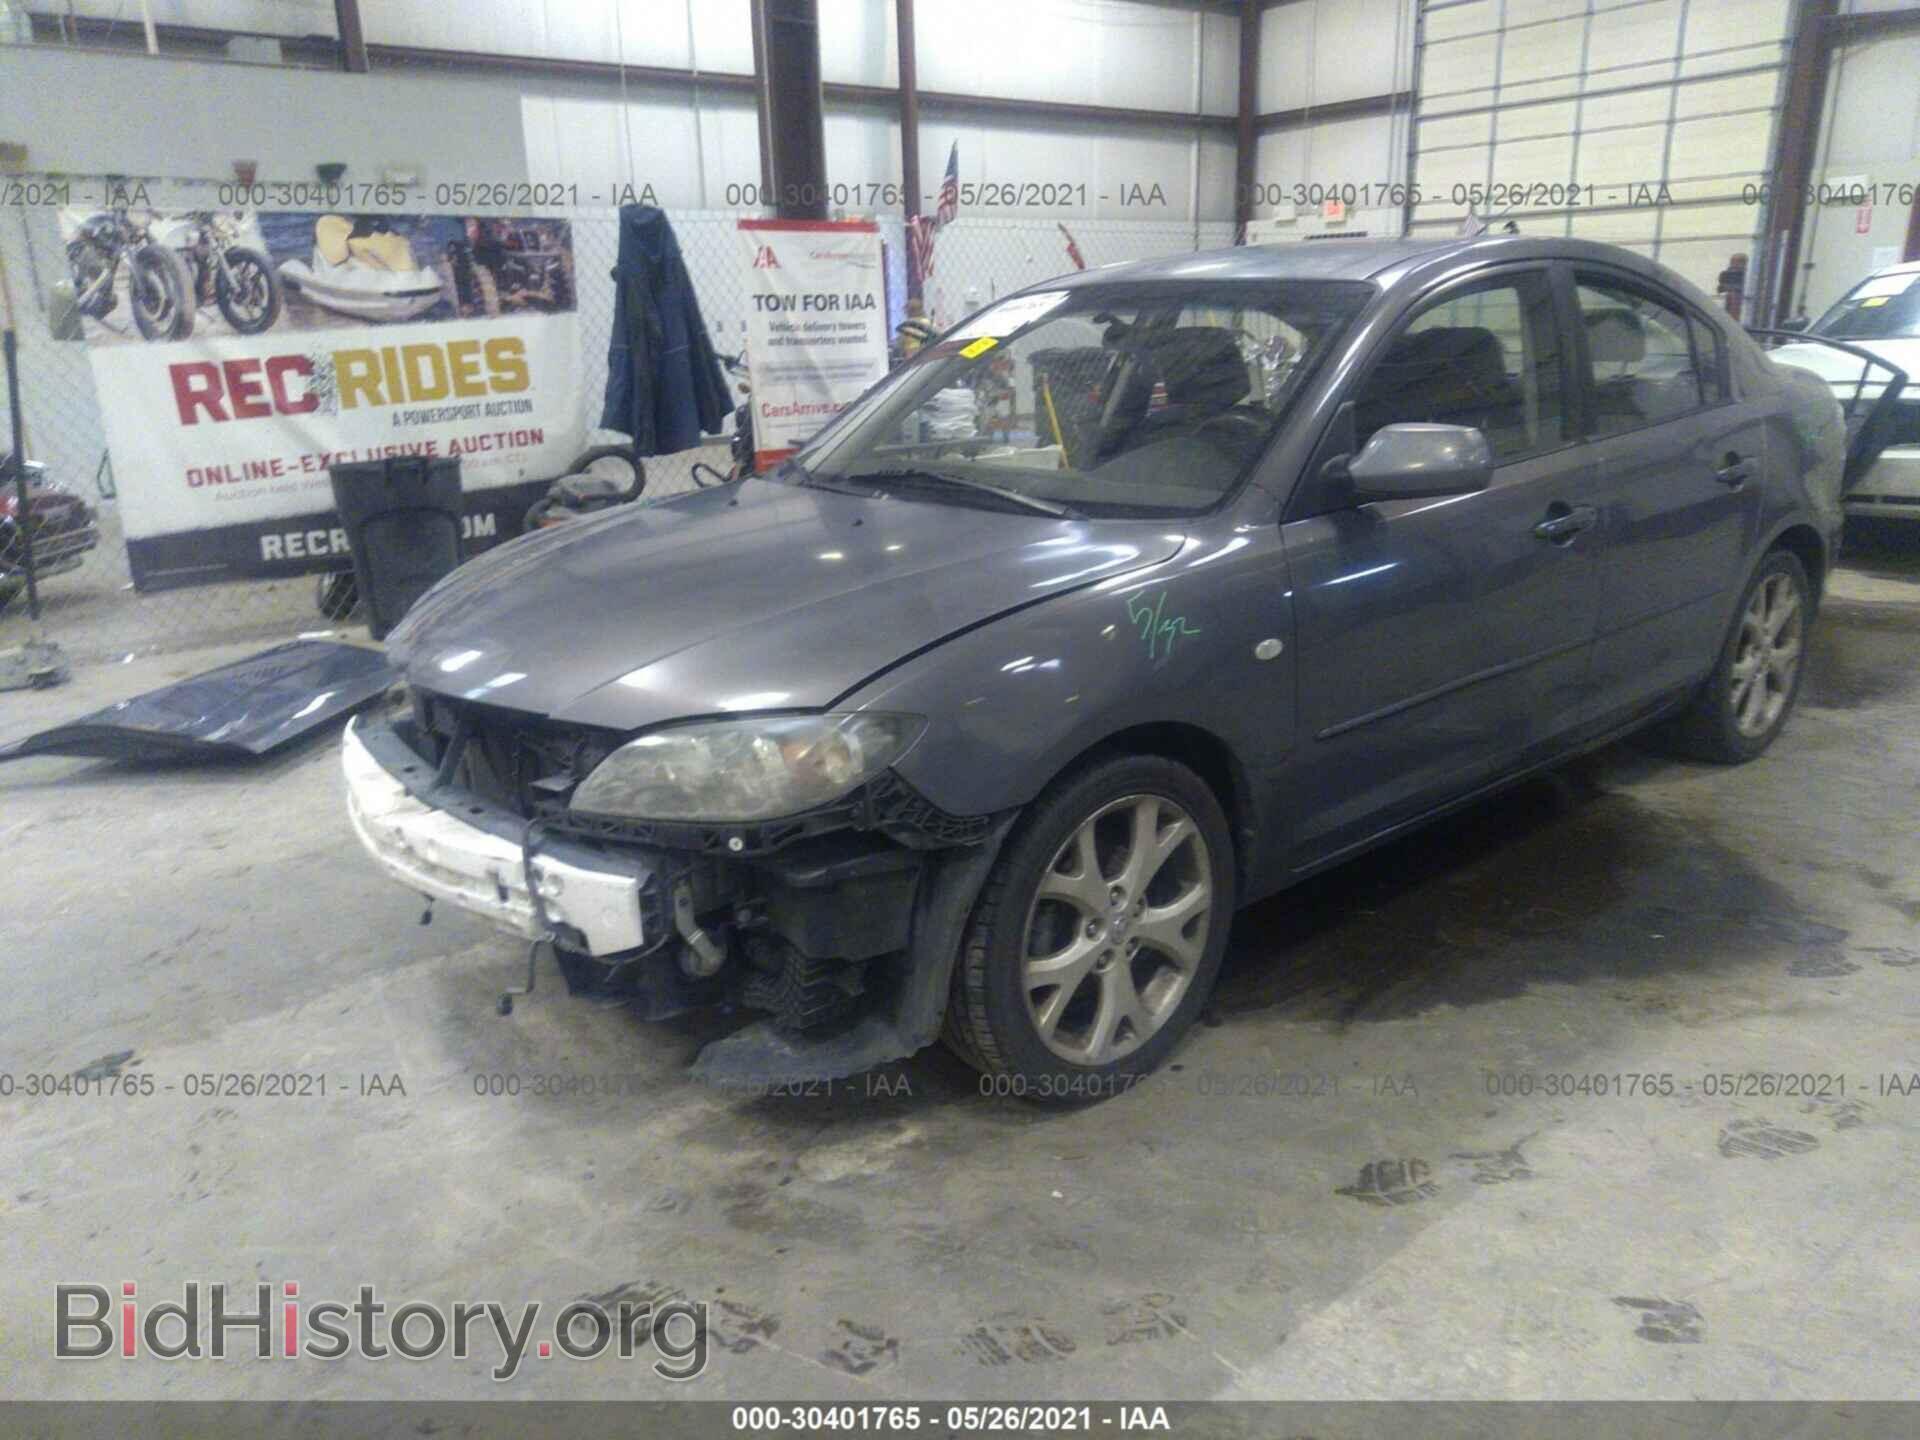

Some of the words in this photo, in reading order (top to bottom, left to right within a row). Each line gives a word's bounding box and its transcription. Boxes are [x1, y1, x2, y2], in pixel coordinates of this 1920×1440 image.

[752, 293, 797, 312] TOW
[802, 293, 840, 312] FOR
[845, 292, 877, 312] IAA
[168, 354, 321, 426] REC
[333, 335, 530, 411] RIDES
[392, 411, 401, 428] A
[402, 403, 481, 426] POWERSPORT
[485, 398, 533, 417] AUCTION
[448, 427, 545, 459] AUCTION
